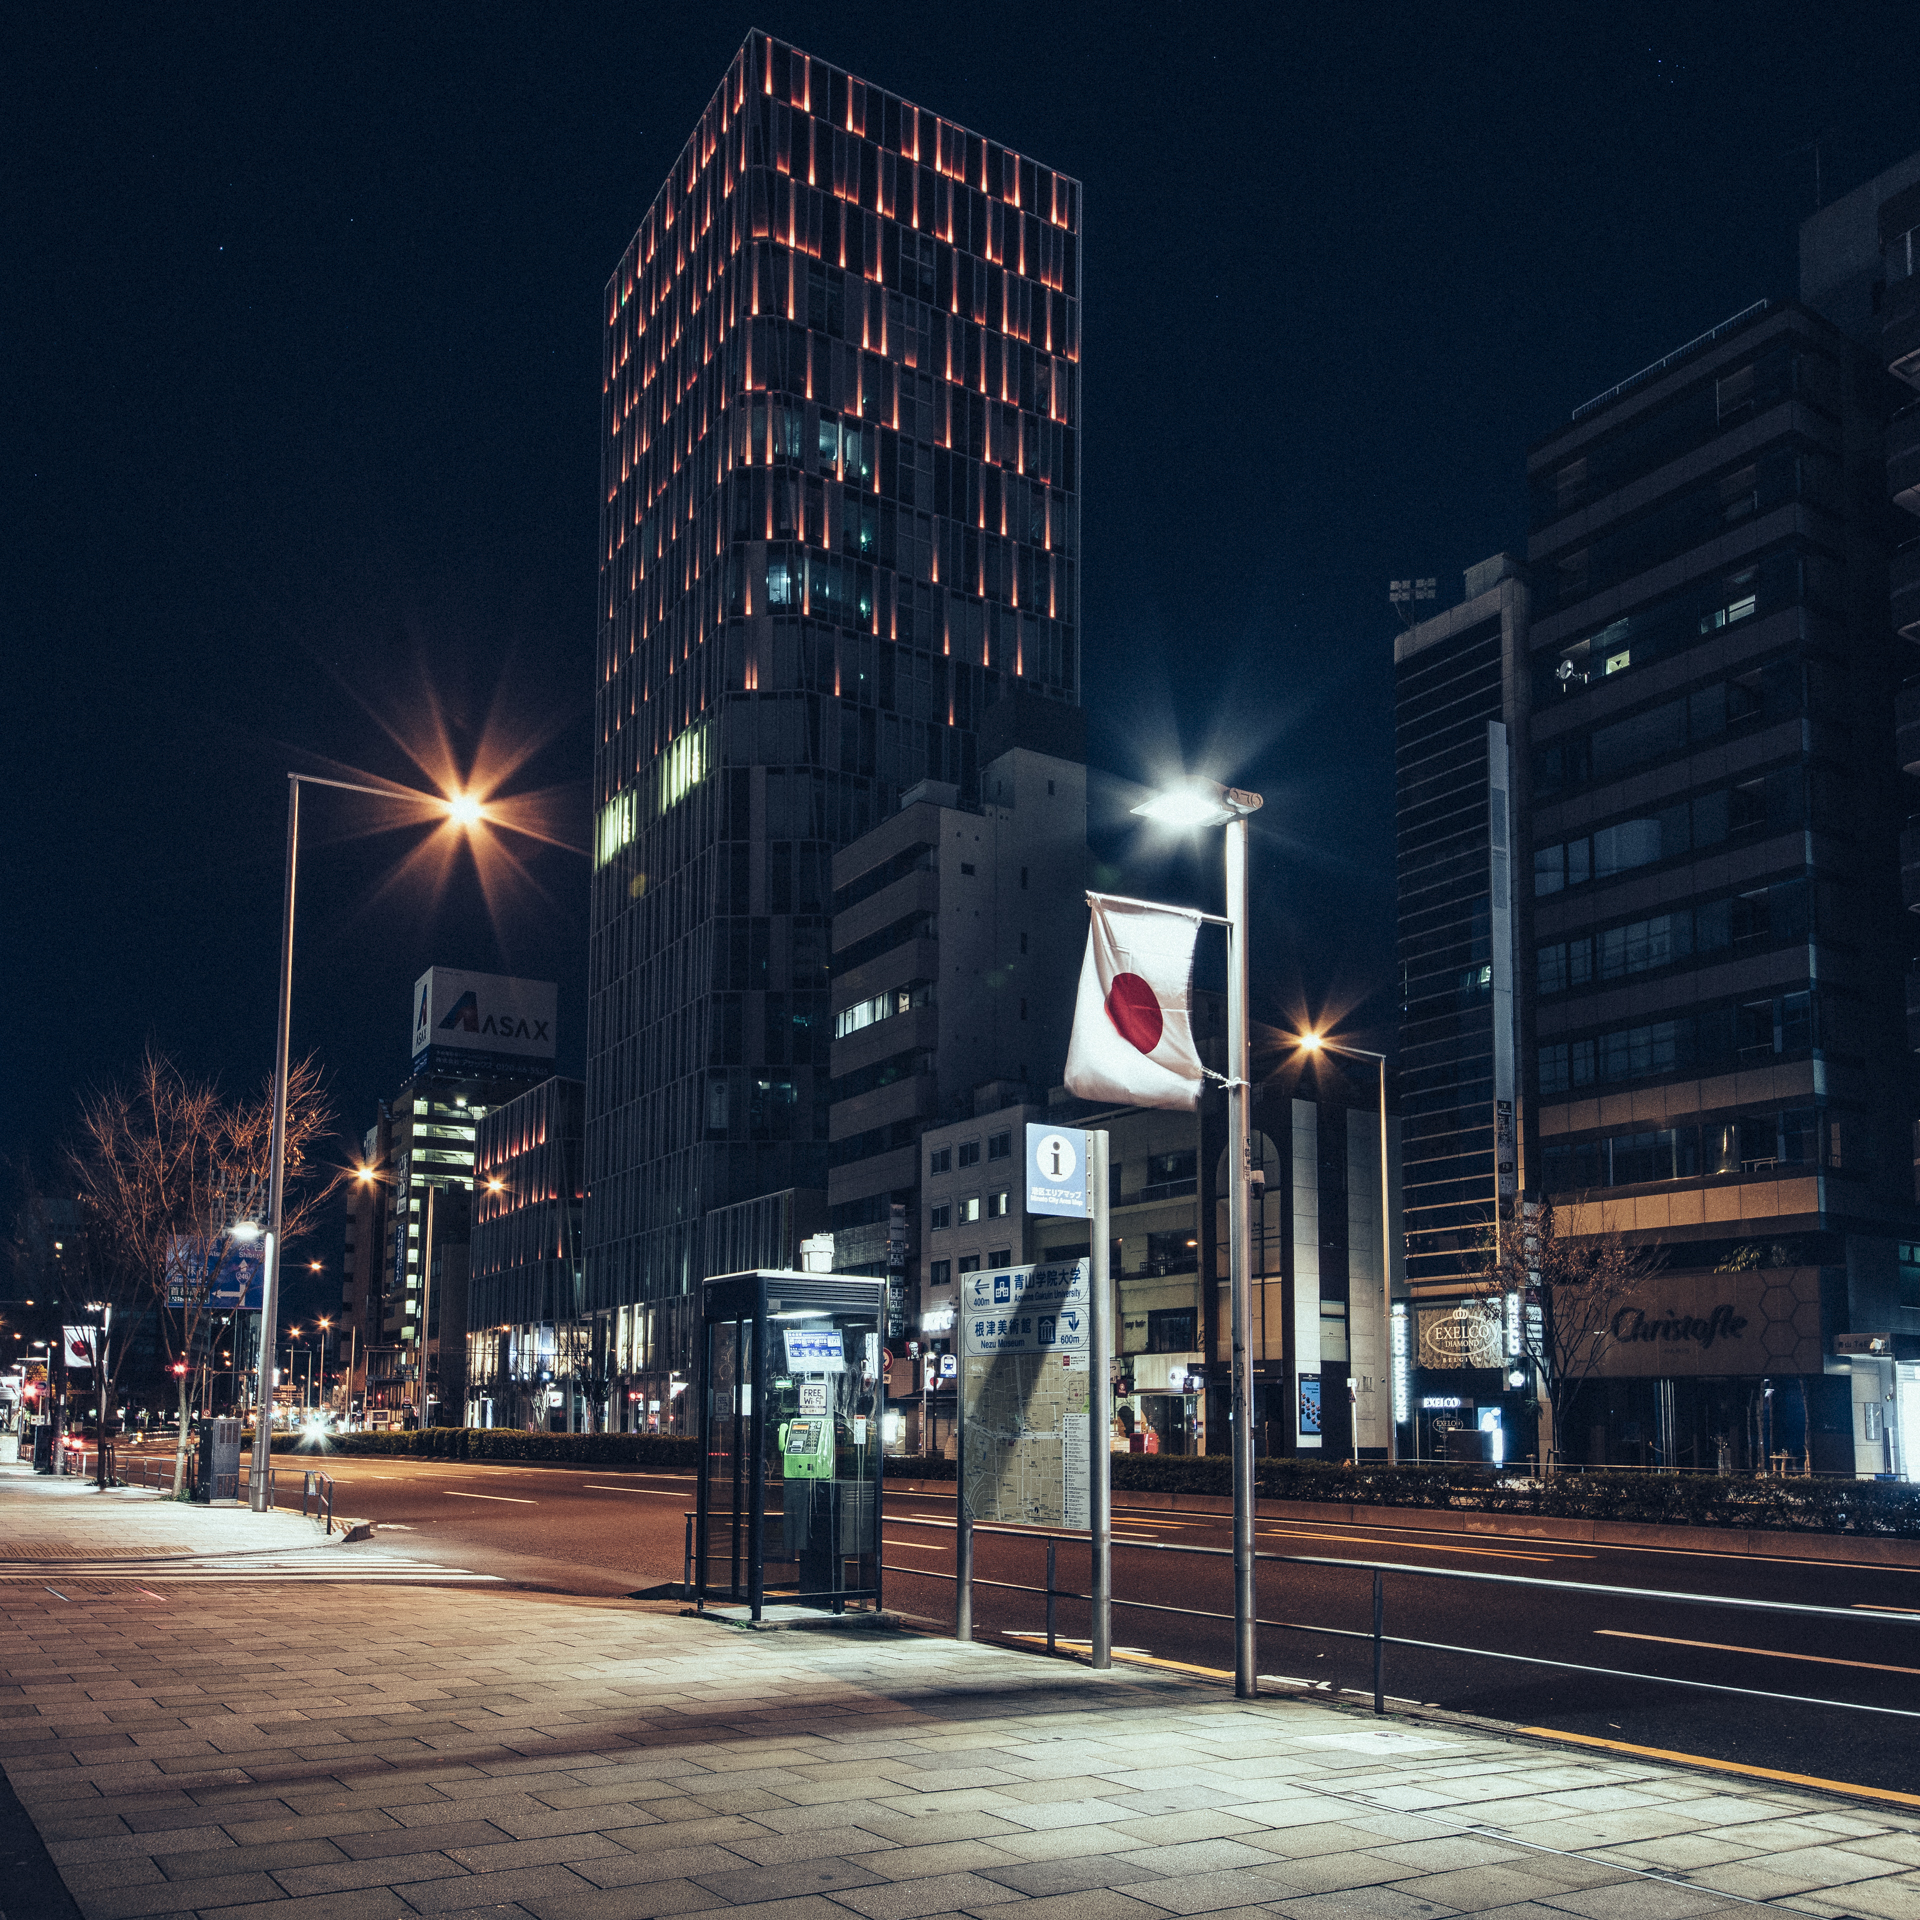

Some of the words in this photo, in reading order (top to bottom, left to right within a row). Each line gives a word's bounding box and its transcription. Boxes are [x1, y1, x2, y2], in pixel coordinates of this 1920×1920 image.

[481, 1014, 549, 1042] ASAX
[1031, 1187, 1082, 1199] 港区エリアマップ
[1014, 1267, 1081, 1291] 青山学院大学
[1014, 1293, 1034, 1303] Aoyama
[1034, 1291, 1054, 1301] Gakuin
[1054, 1288, 1081, 1299] University
[973, 1297, 990, 1307] 400m
[974, 1318, 1032, 1338] 根津美術館
[1612, 1304, 1748, 1349] Christofle
[1435, 1325, 1490, 1340] EXELCO
[980, 1340, 996, 1349] Nezu
[997, 1338, 1025, 1348] Museum
[1060, 1334, 1080, 1345] 600m
[1445, 1339, 1480, 1348] DIAMOND
[803, 1388, 822, 1397] FREE
[803, 1396, 822, 1405] Wi-Fi
[1423, 1397, 1461, 1408] EXELCO
